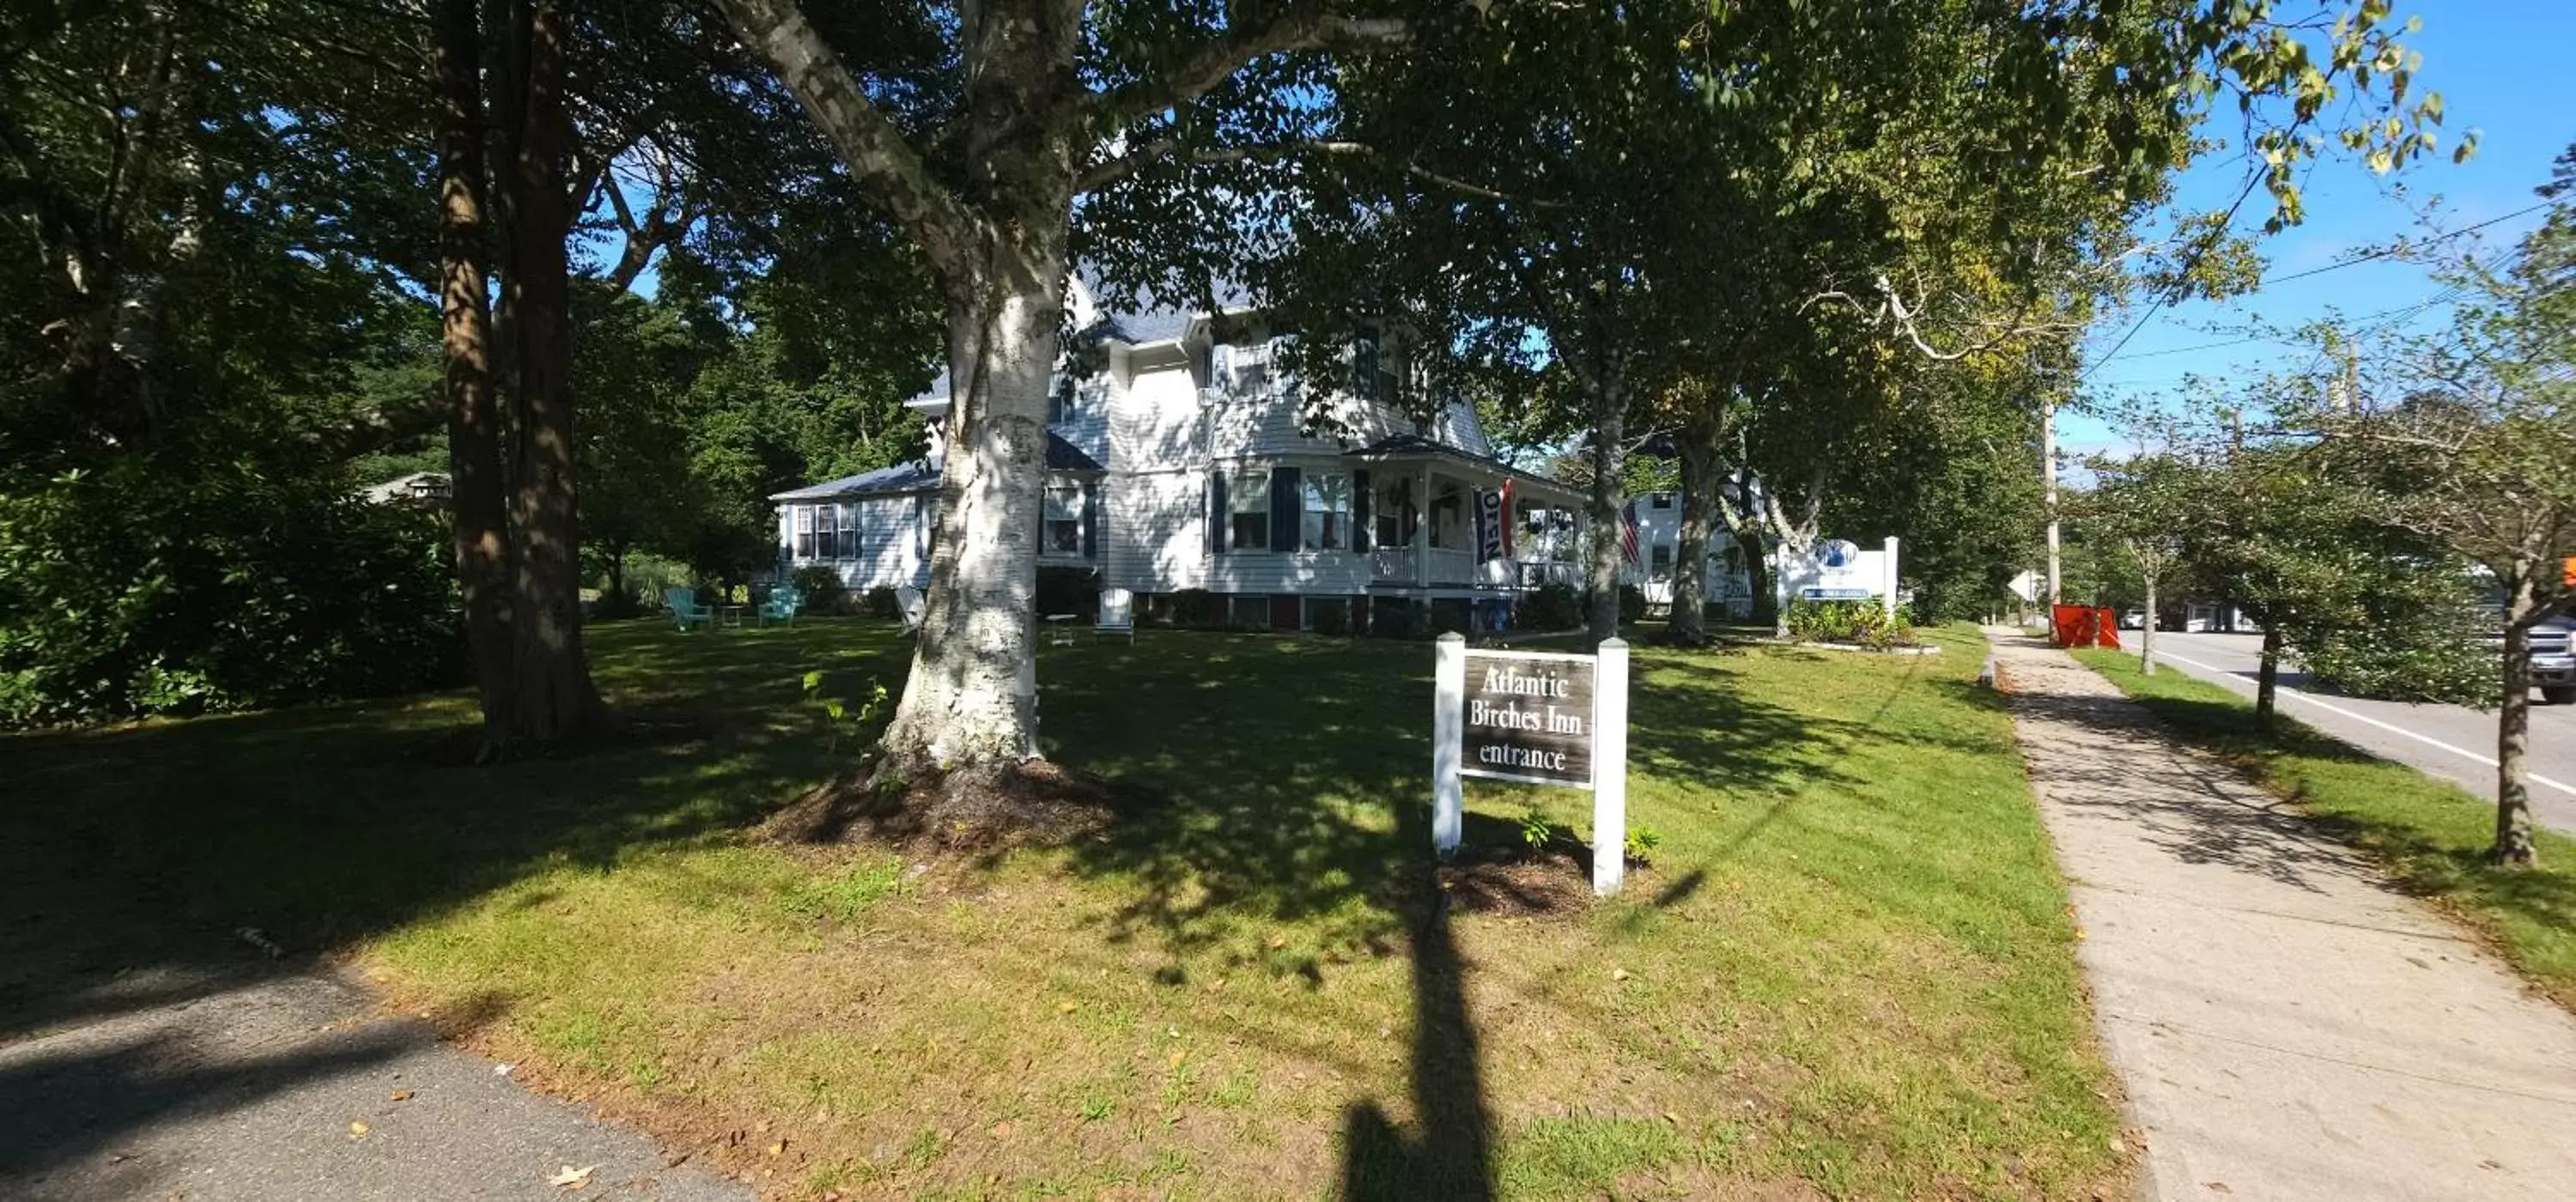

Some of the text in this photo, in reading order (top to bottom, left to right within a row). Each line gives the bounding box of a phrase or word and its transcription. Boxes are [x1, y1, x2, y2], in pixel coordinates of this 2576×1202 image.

[1484, 491, 1500, 560] OPEN
[1480, 665, 1570, 698] Atlantic
[1469, 699, 1583, 734] Birches Inn
[1479, 743, 1566, 770] entrance
